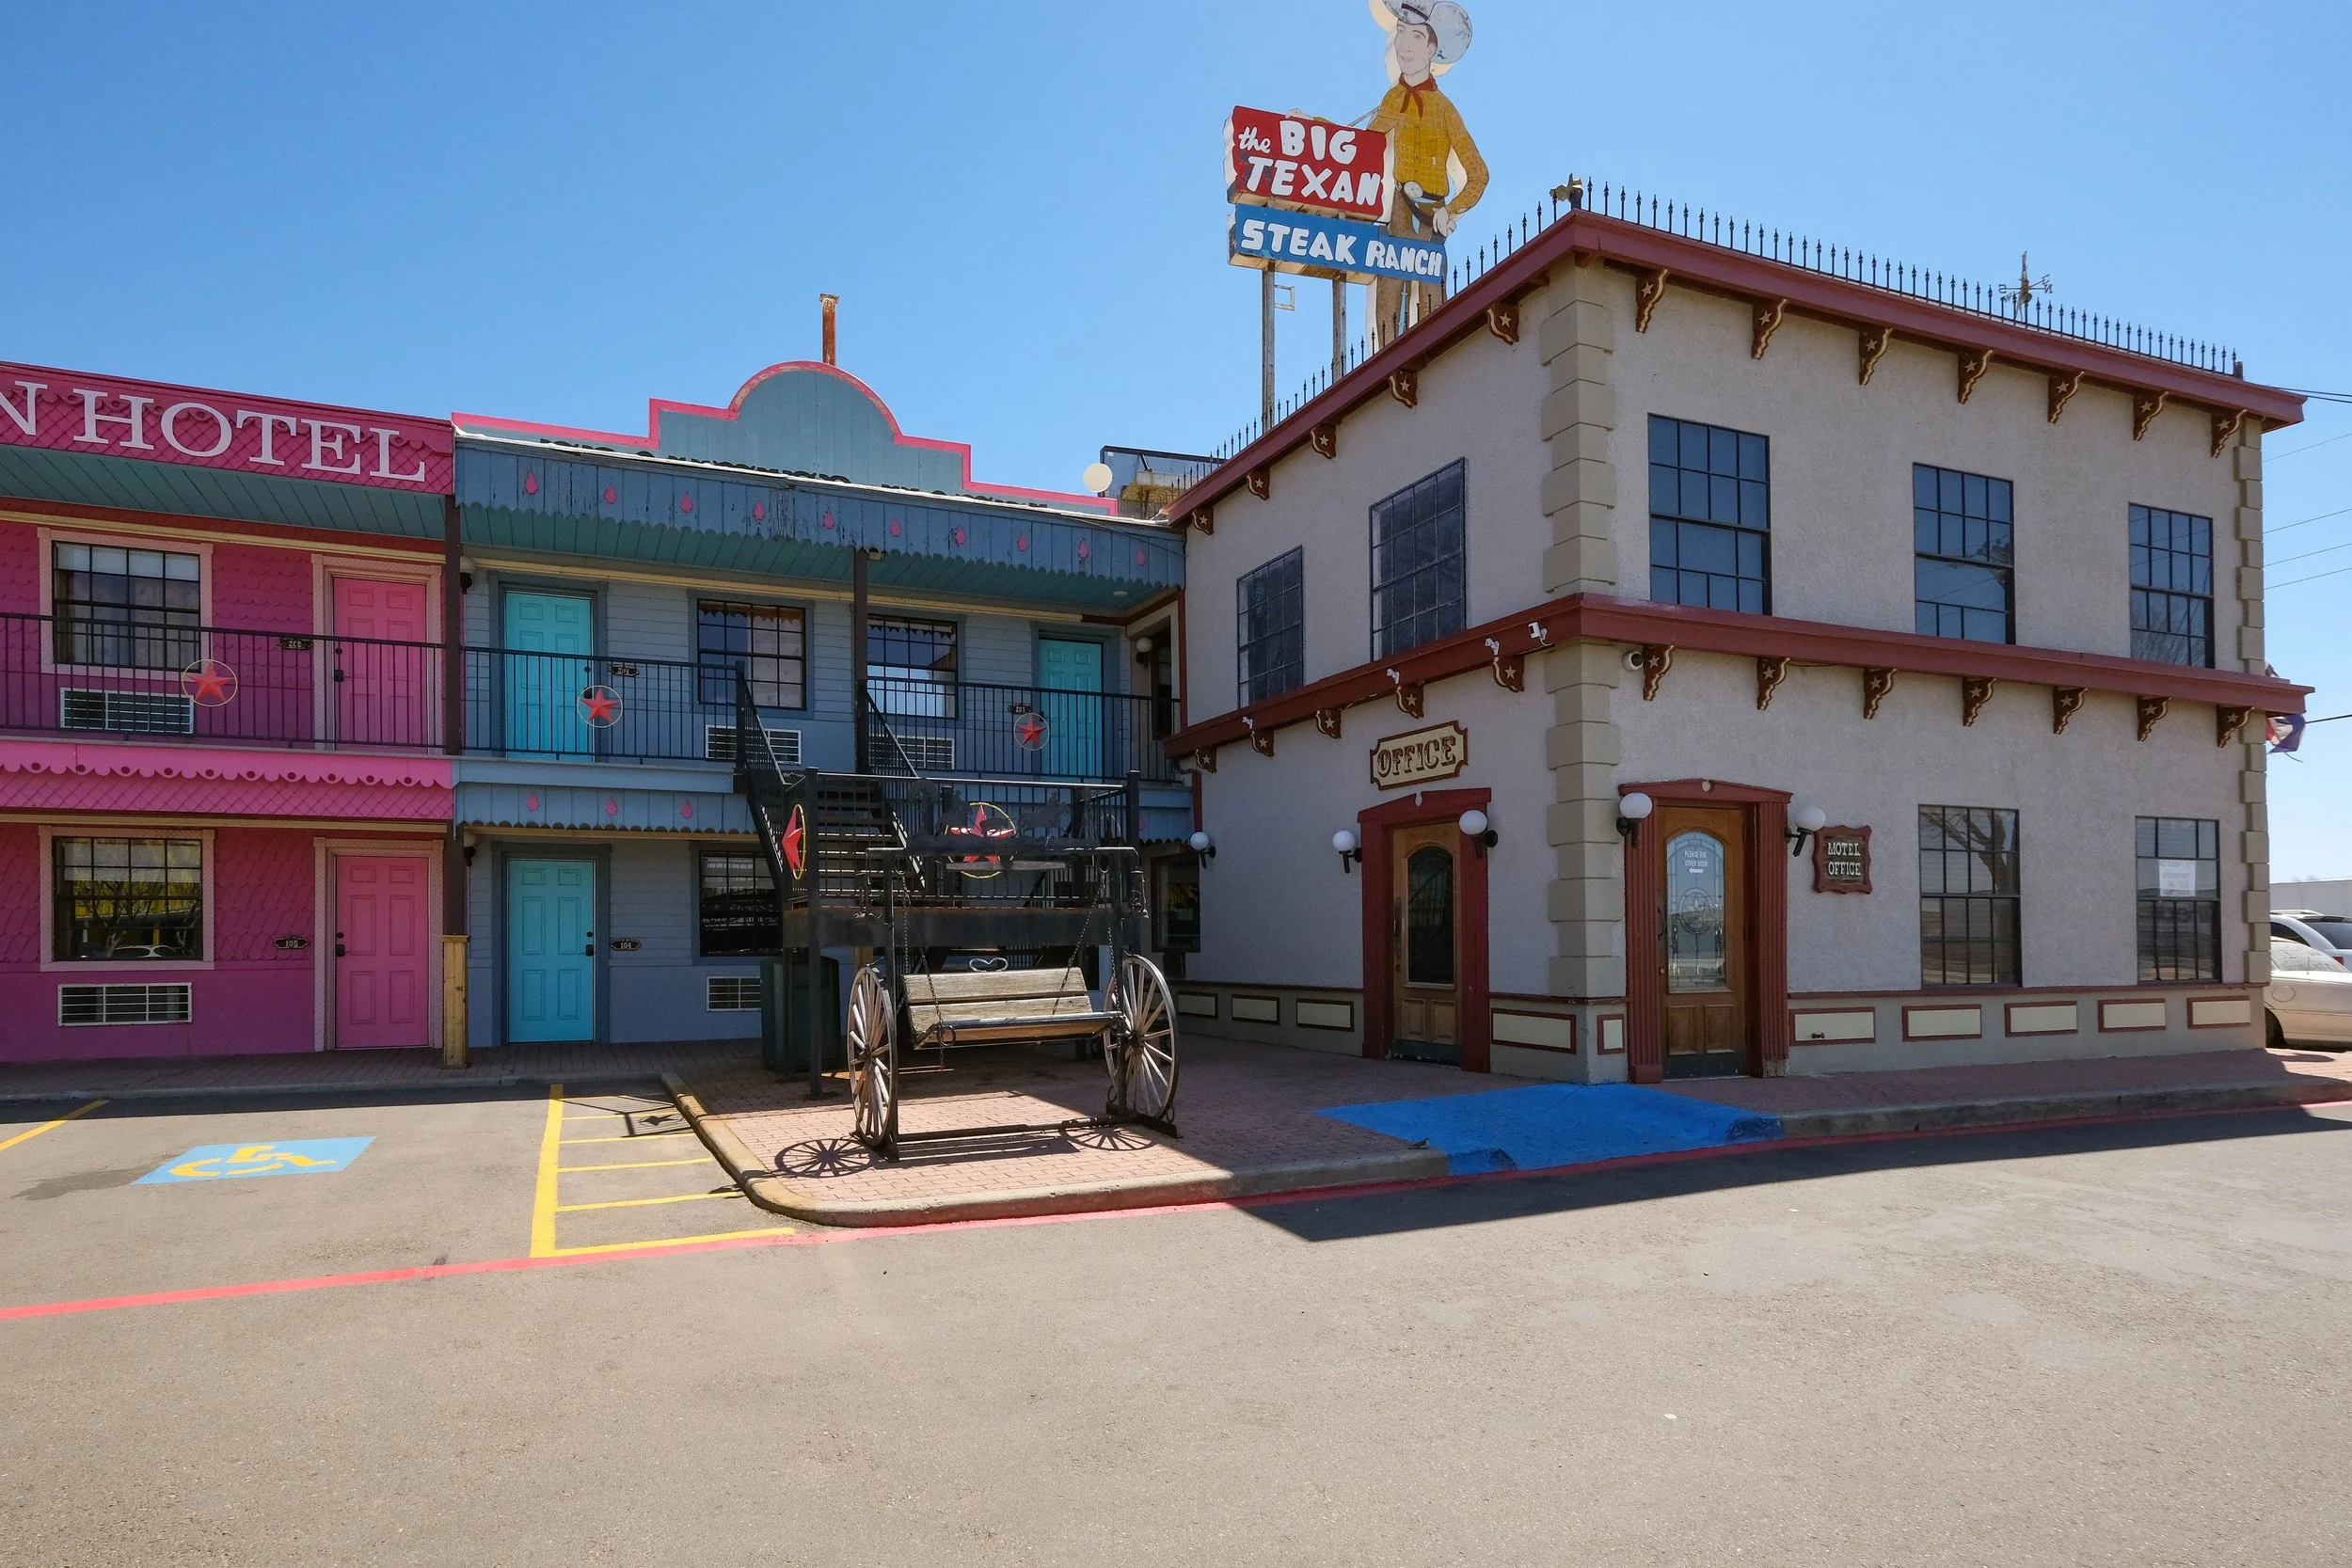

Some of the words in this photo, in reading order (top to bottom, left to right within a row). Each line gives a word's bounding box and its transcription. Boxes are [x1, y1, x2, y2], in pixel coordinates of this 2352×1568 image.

[1238, 126, 1271, 152] the
[1279, 119, 1357, 165] BIG
[1247, 155, 1381, 206] TEXAN
[1241, 218, 1357, 265] STEAK
[1365, 240, 1443, 277] RANCH
[72, 388, 425, 483] HOTEL
[1377, 736, 1456, 777] OFFICE
[1827, 842, 1861, 856] MOTEL
[1828, 862, 1862, 876] OFFICE
[285, 940, 299, 948] 105
